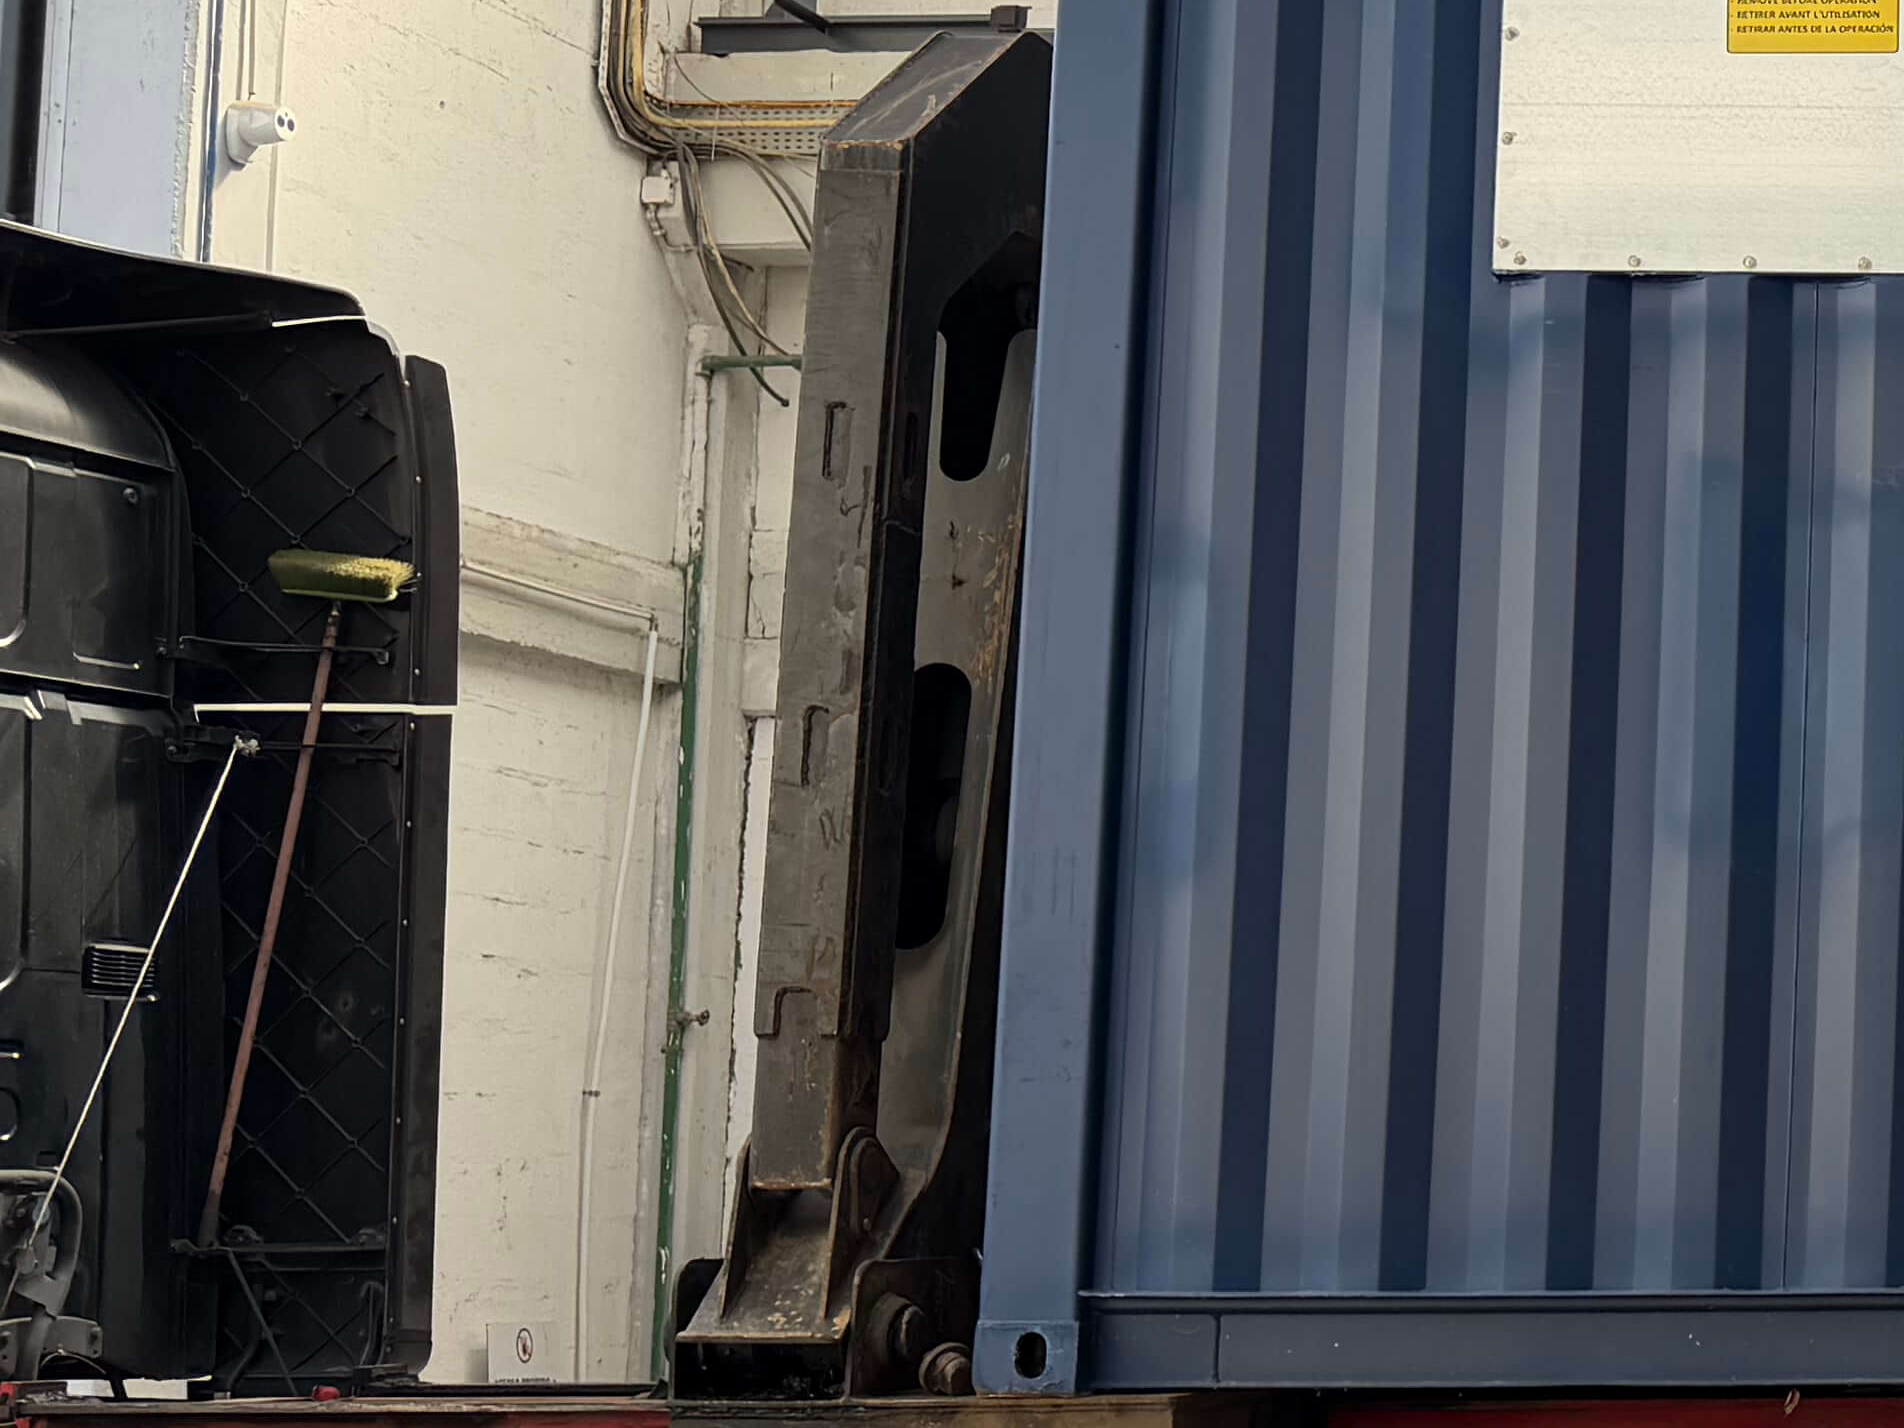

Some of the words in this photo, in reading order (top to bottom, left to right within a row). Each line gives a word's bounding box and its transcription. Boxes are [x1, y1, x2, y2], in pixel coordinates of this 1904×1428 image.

[1737, 10, 1776, 19] RETIRER
[1778, 10, 1811, 19] AVANT
[1737, 25, 1776, 34] RETIRAR
[1778, 25, 1808, 34] ANTES
[1810, 25, 1822, 33] DE
[1825, 25, 1836, 33] LA
